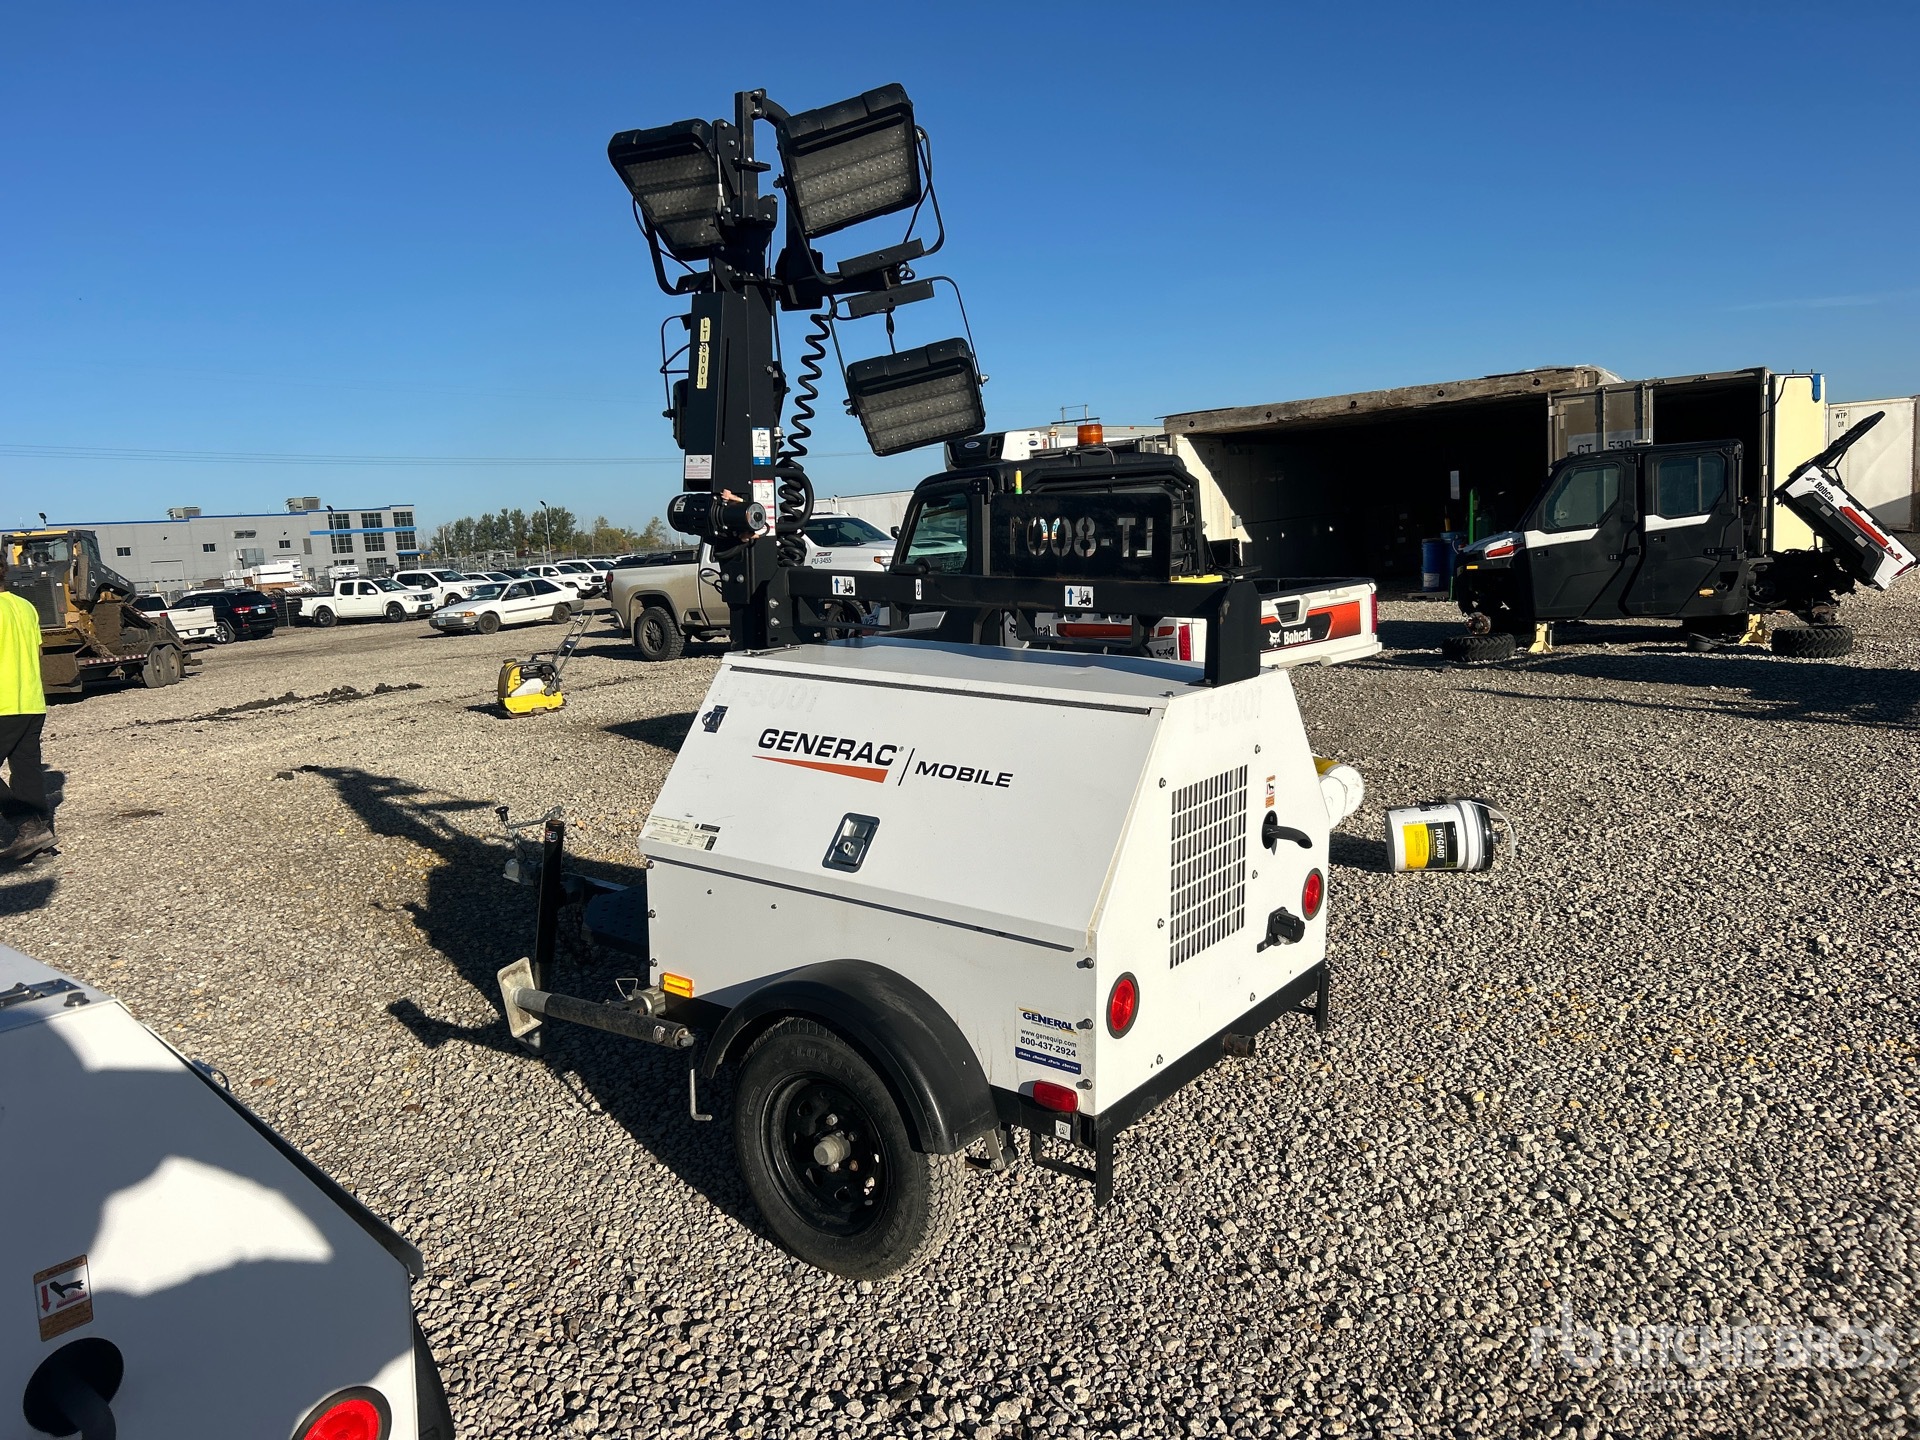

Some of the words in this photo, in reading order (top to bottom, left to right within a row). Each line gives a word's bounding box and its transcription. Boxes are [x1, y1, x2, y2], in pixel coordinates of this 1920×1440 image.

[1283, 628, 1312, 645] Bobcat
[758, 728, 897, 766] GENERAC
[915, 761, 1013, 788] MOBILE
[1022, 1011, 1074, 1032] GENERAL
[1020, 1029, 1077, 1048] www.genequip.com
[1020, 1036, 1077, 1057] 800-437-2924
